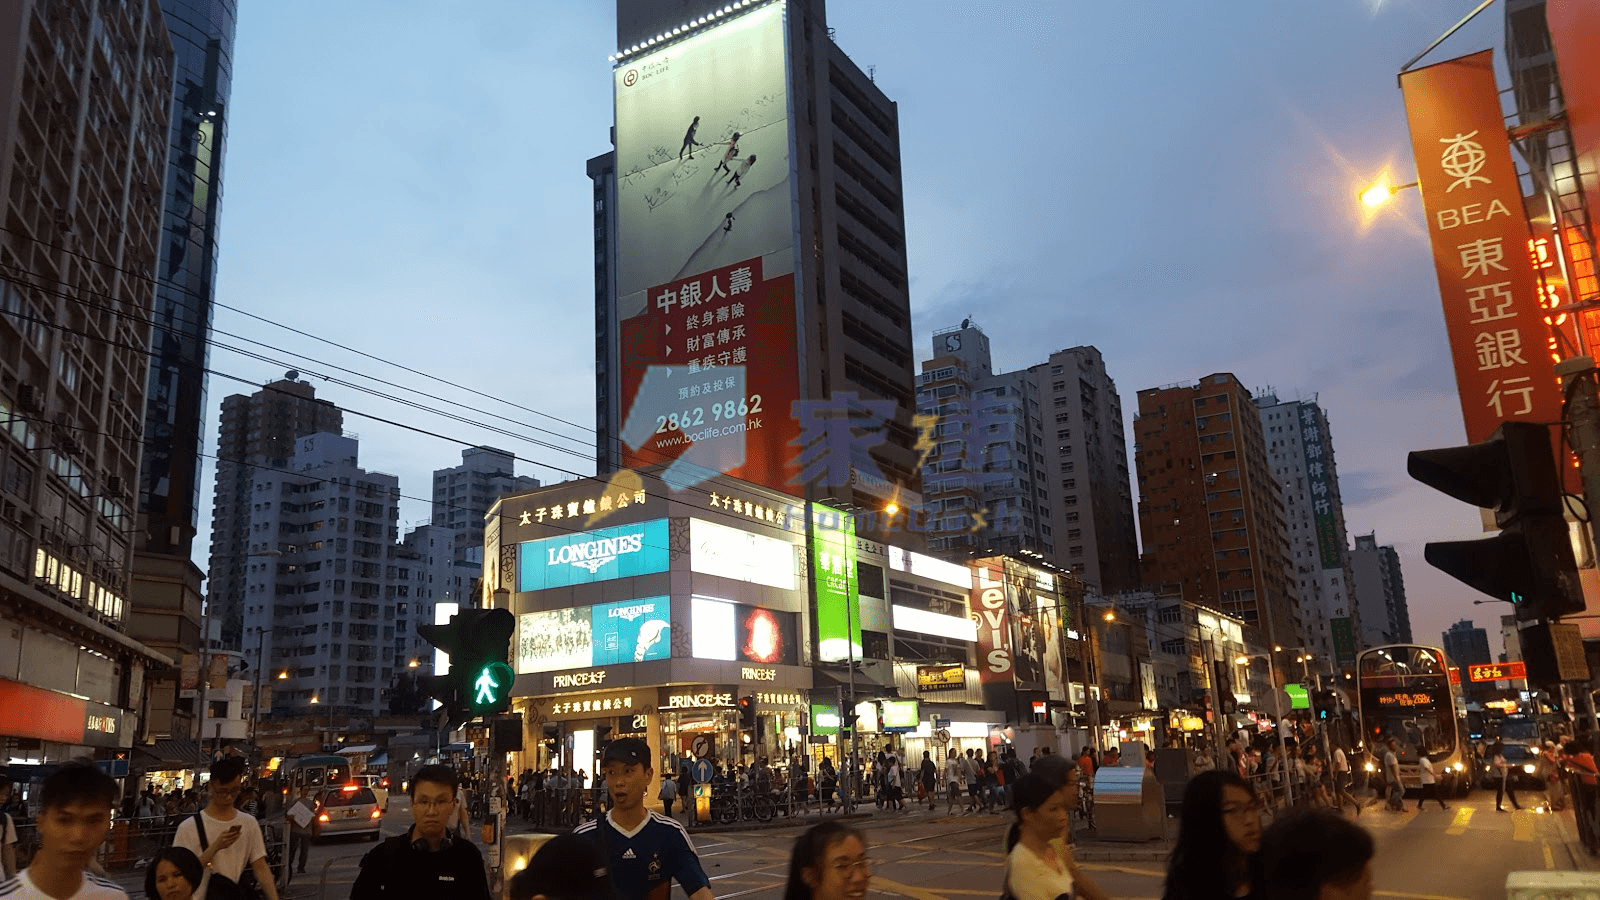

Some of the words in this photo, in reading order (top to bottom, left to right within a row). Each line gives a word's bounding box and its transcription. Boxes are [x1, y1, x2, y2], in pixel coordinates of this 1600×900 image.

[656, 65, 669, 75] LIFE
[1436, 199, 1511, 231] BEA
[656, 266, 753, 314] 中銀人壽
[686, 302, 745, 331] 終身壽險
[1457, 237, 1534, 418] 東亞銀行
[686, 324, 746, 353] 財富傳承
[687, 346, 747, 375] 重疾守護
[678, 376, 736, 400] 預約及投保
[655, 407, 704, 434] 2862
[711, 394, 763, 421] 9862
[656, 418, 763, 449] www.boclife.com.hk
[518, 489, 646, 527] 太子珠寶鐘錶公司
[547, 533, 643, 566] LONGINES
[607, 603, 655, 618] LONGINES
